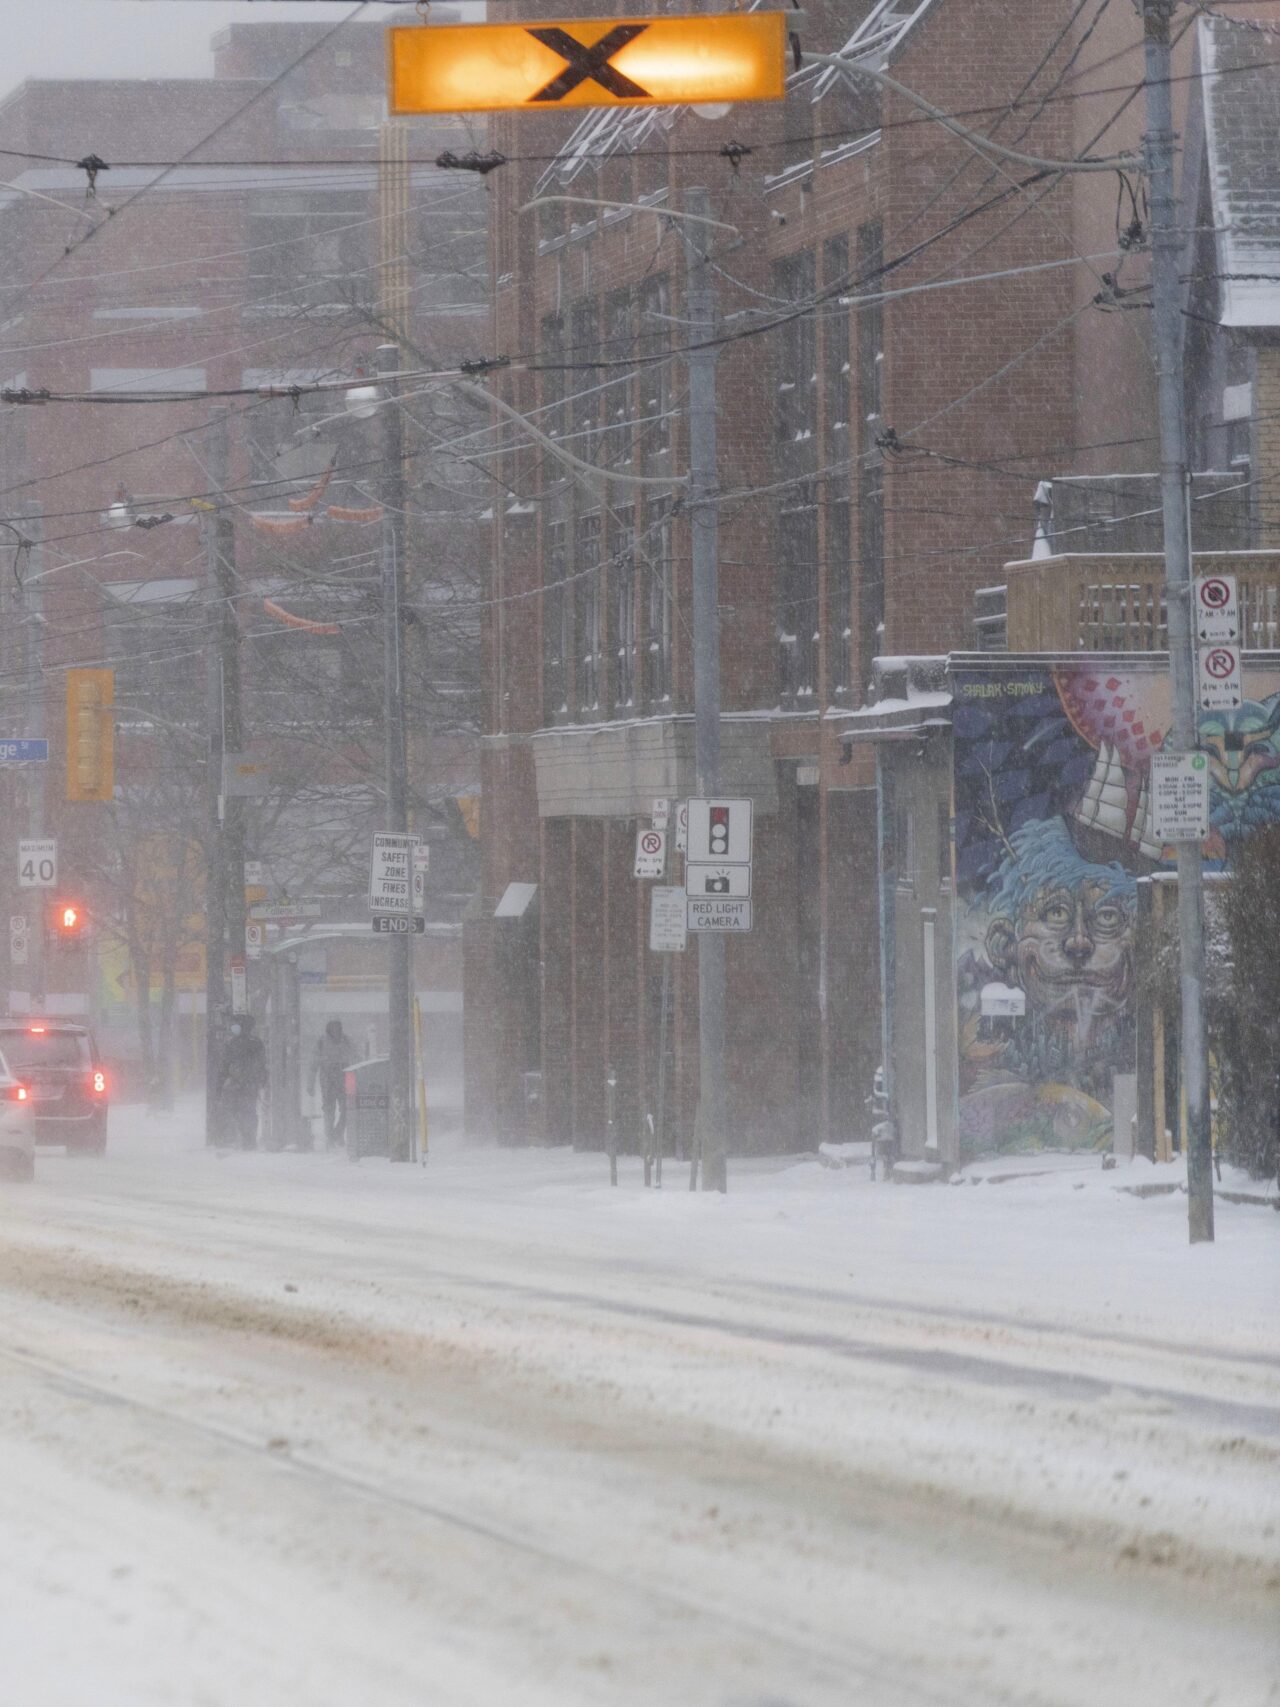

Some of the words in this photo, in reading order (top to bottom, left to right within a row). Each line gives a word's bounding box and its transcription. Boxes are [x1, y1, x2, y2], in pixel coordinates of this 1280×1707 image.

[1198, 609, 1203, 618] 7
[381, 852, 407, 864] SAFET
[21, 859, 54, 881] 40
[385, 866, 406, 878] ZONE
[382, 882, 406, 894] FINES
[693, 903, 713, 914] RED
[716, 903, 744, 914] LIGHT
[380, 918, 417, 932] ENDS
[697, 917, 740, 927] CAMERA
